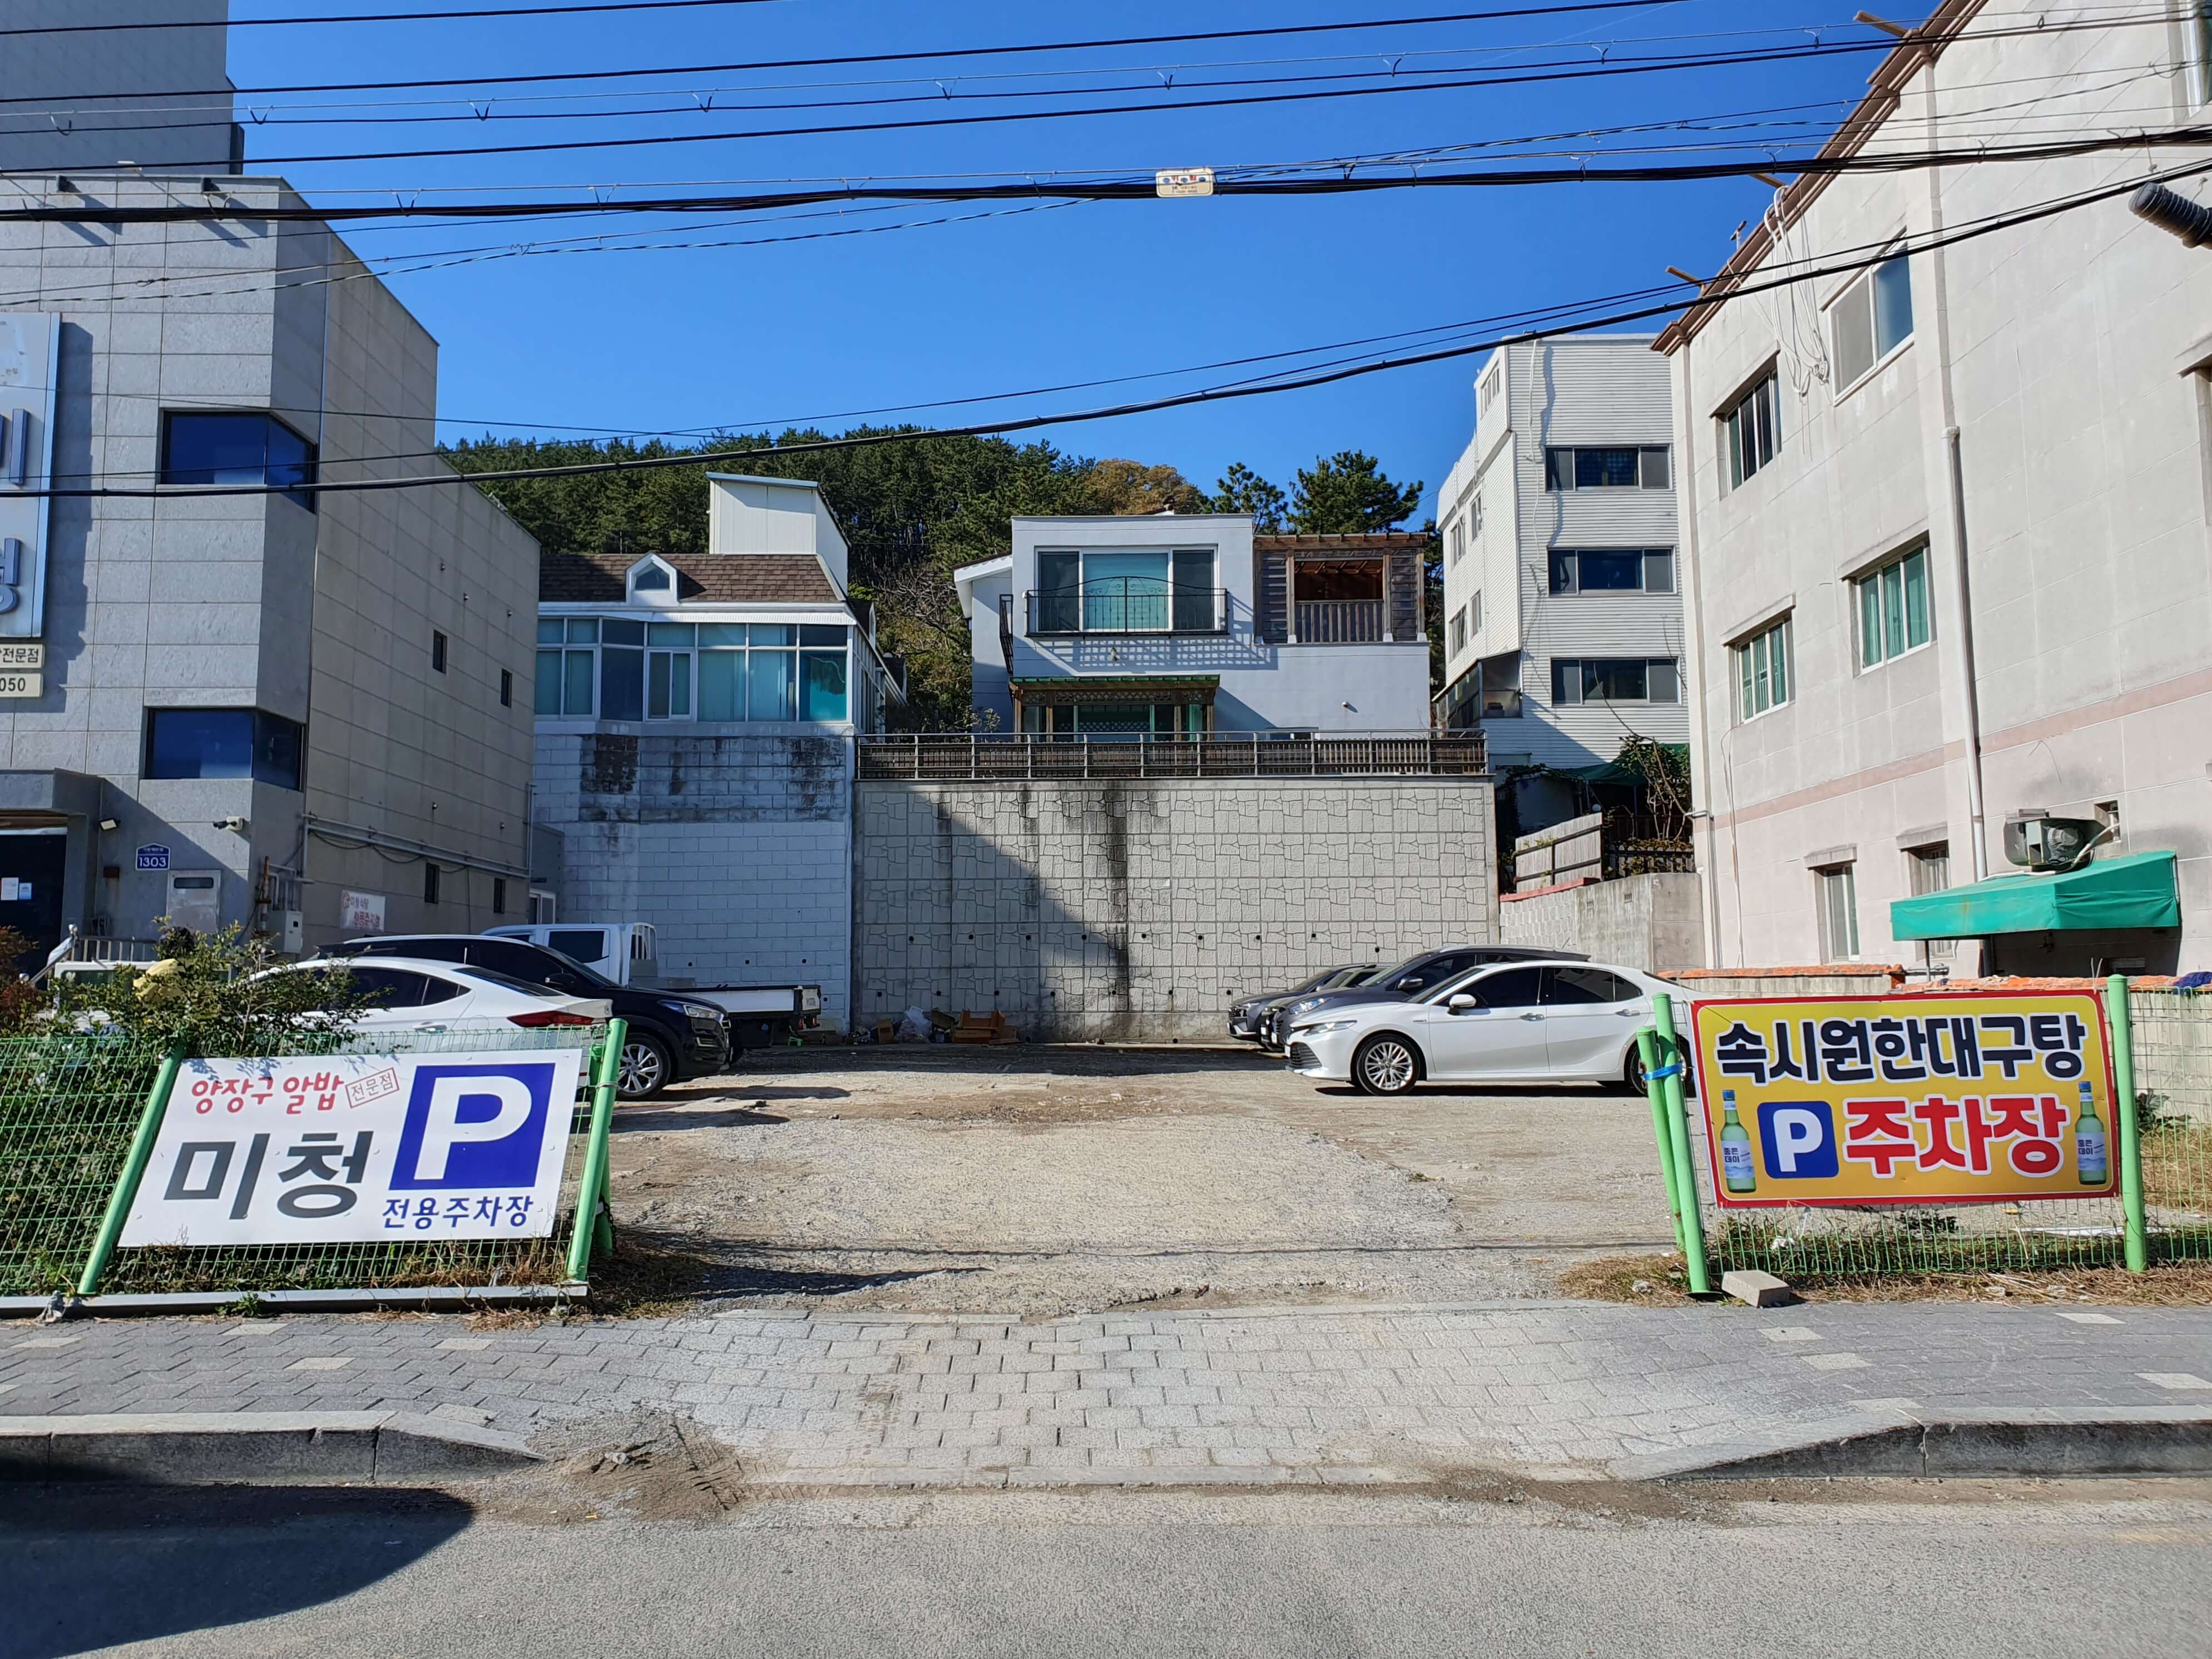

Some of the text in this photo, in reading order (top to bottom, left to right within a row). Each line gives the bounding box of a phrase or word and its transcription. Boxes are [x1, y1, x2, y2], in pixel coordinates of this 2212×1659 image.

[0, 648, 39, 663] 전문점
[139, 857, 166, 867] 1303
[1716, 1013, 2087, 1085] 속시원한대구탕
[191, 1071, 345, 1114] 양장구 알밥
[349, 1073, 395, 1104] 전문점
[414, 1075, 532, 1180] P
[1774, 1108, 1823, 1172] P
[1845, 1096, 2067, 1176] 주차장
[163, 1130, 374, 1220] 미청
[382, 1195, 535, 1230] 전용주차장
